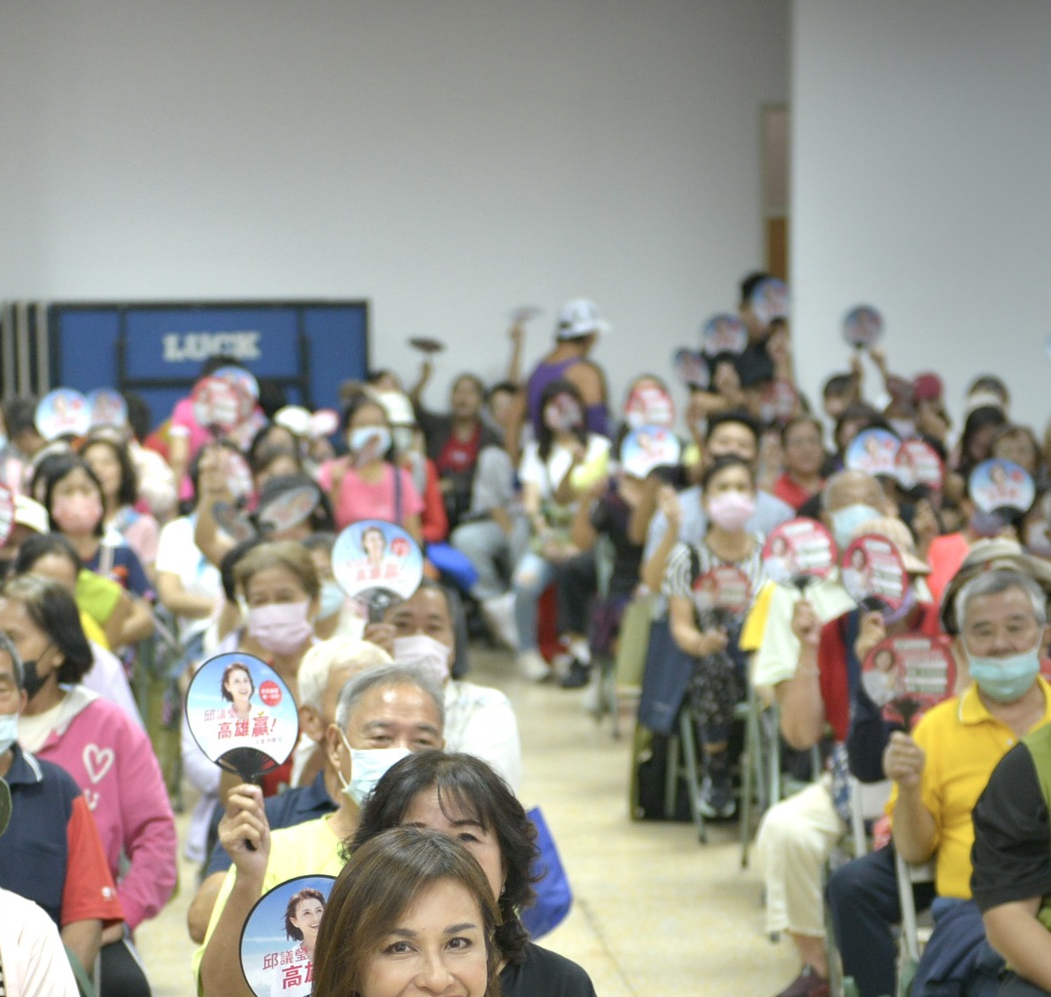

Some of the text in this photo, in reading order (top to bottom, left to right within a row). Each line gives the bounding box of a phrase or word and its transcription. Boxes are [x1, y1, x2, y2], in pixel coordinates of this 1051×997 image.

[163, 332, 261, 361] LUCK
[262, 947, 308, 970] 邱議瑩
